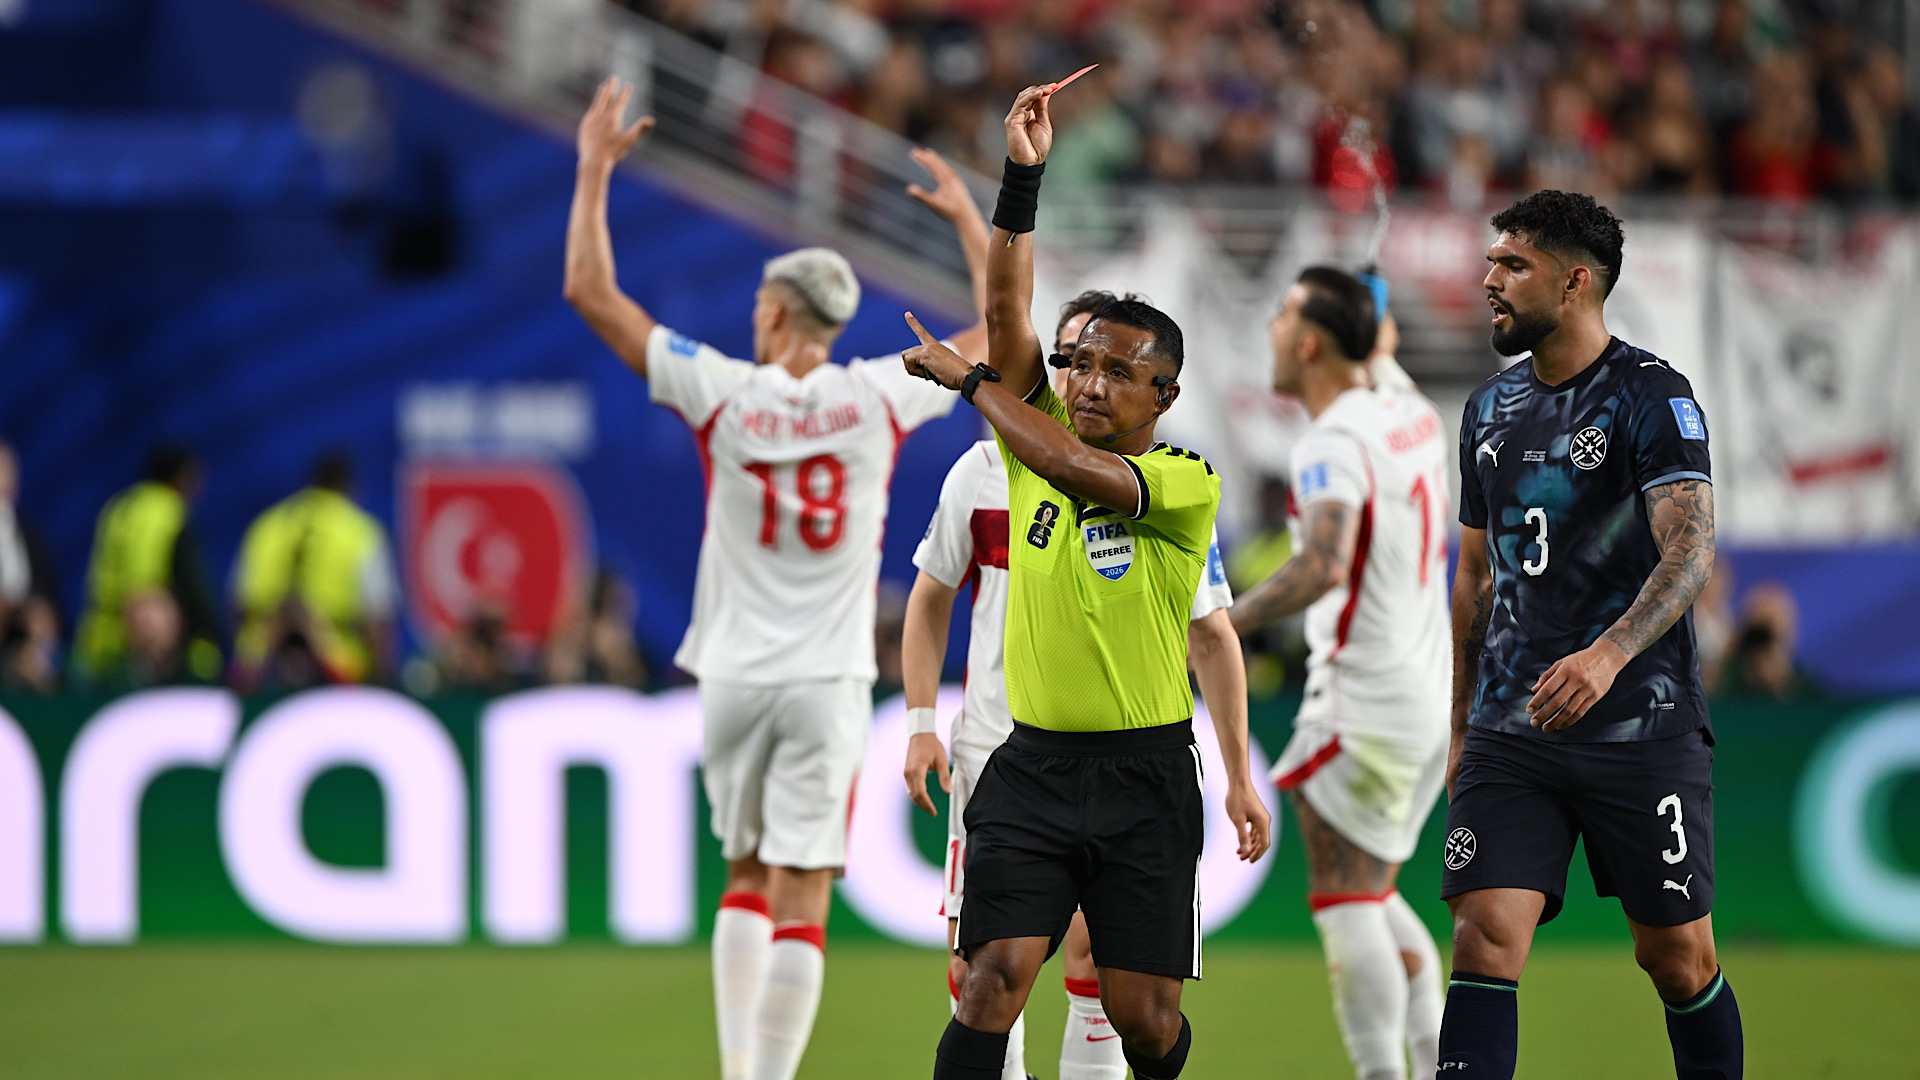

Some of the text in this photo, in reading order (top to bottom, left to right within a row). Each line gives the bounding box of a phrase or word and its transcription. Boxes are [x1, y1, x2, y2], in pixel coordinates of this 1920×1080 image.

[1585, 430, 1597, 438] APF
[742, 452, 849, 554] 18
[1032, 535, 1043, 545] FIFA
[1086, 522, 1129, 543] FIFA
[1522, 507, 1548, 576] 3
[1090, 545, 1132, 560] REFEREE
[1105, 567, 1124, 576] 2026
[1453, 830, 1464, 840] APF
[1656, 793, 1688, 865] 3
[950, 839, 966, 896] 1
[1435, 1061, 1469, 1072] APF
